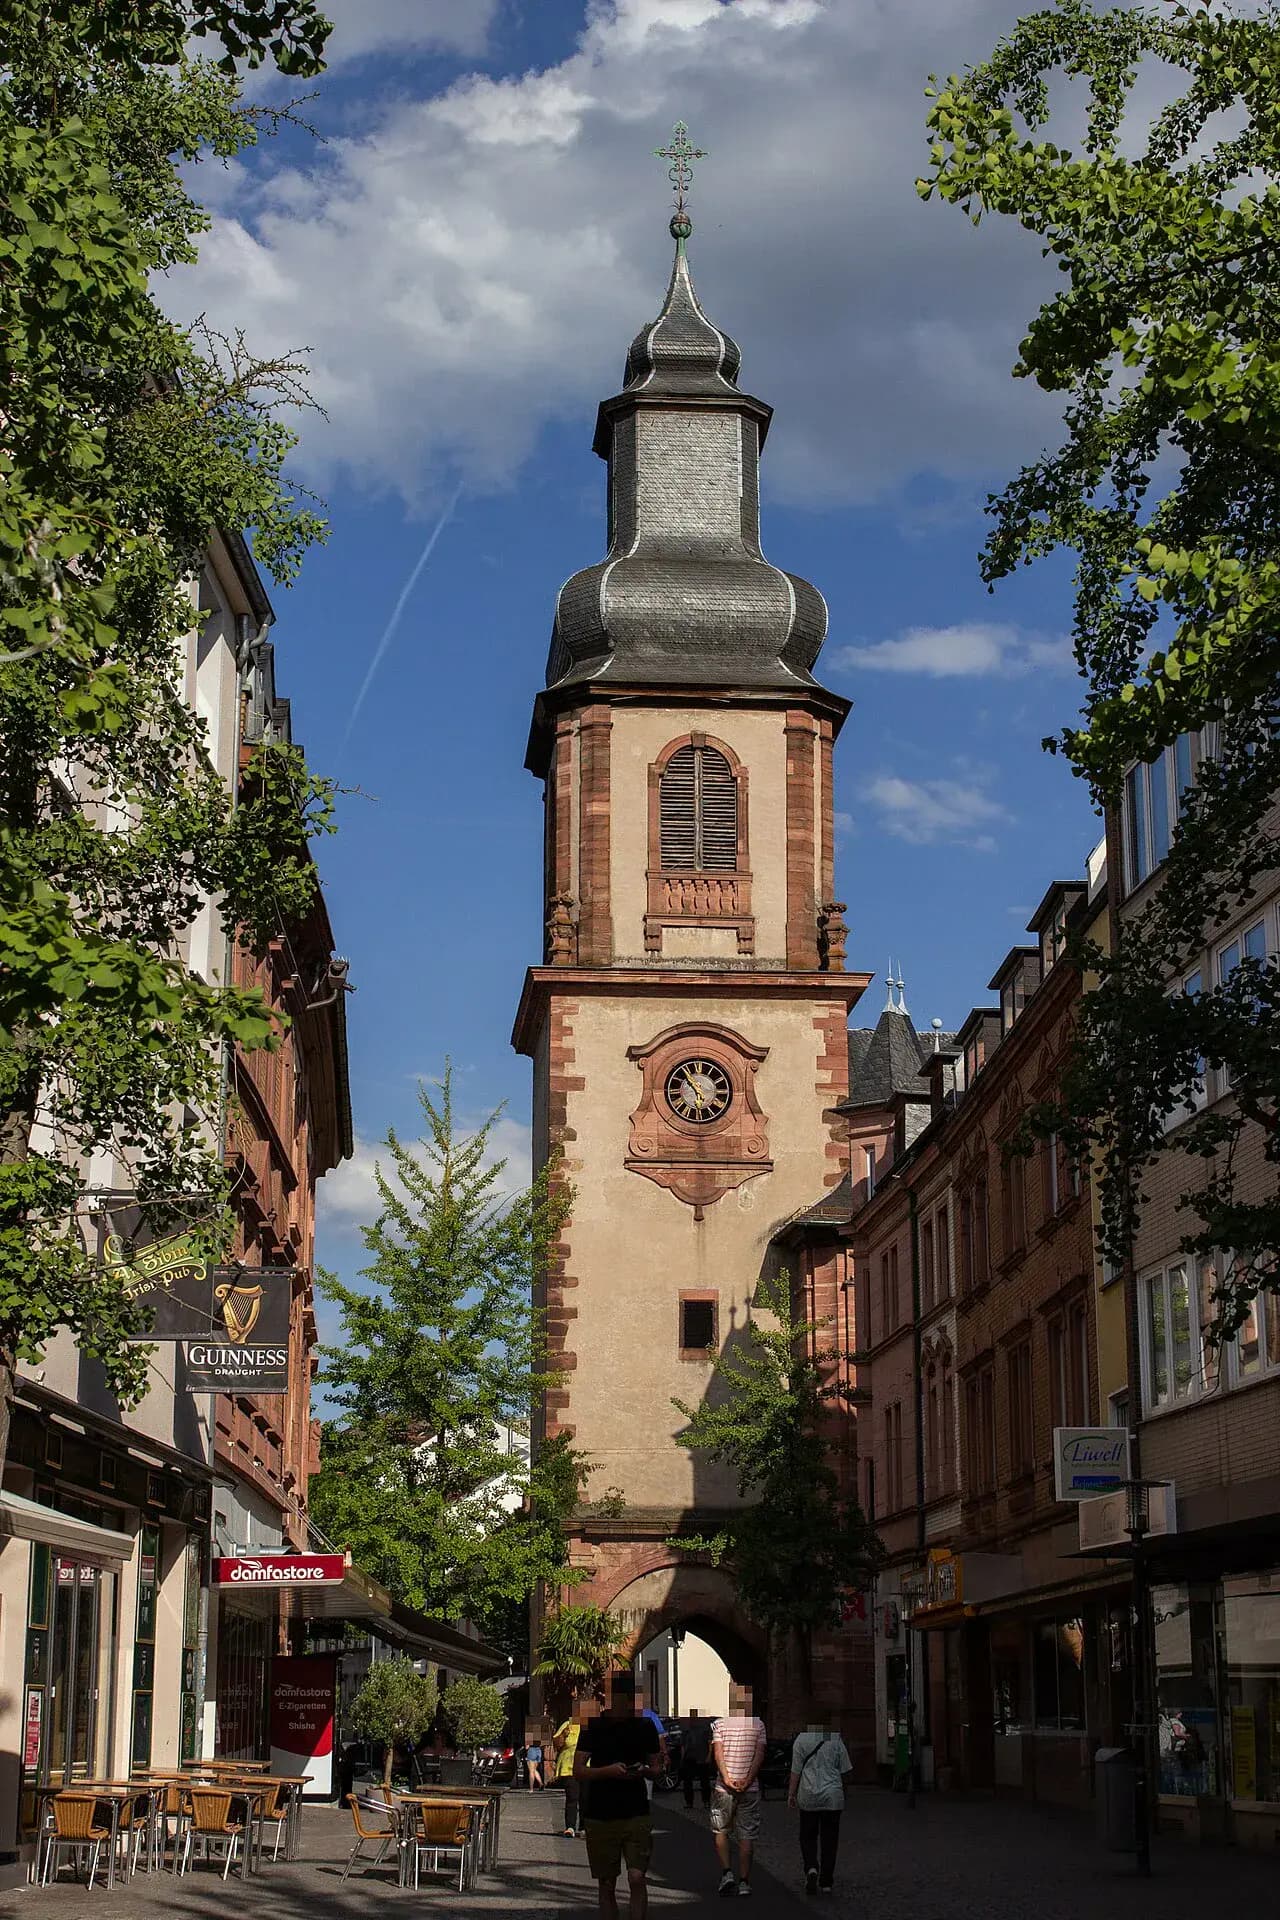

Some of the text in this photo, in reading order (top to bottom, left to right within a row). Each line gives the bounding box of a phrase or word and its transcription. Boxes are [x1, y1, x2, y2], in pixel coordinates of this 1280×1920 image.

[122, 1267, 190, 1301] Irish Pub
[189, 1345, 287, 1366] GUINNESS
[214, 1368, 262, 1376] DRAUGHT
[1072, 1442, 1124, 1462] Liwell
[230, 1563, 325, 1581] damfastore
[273, 1686, 332, 1698] damfastore
[279, 1702, 327, 1713] E-Zigaretten
[288, 1721, 316, 1731] Shisha
